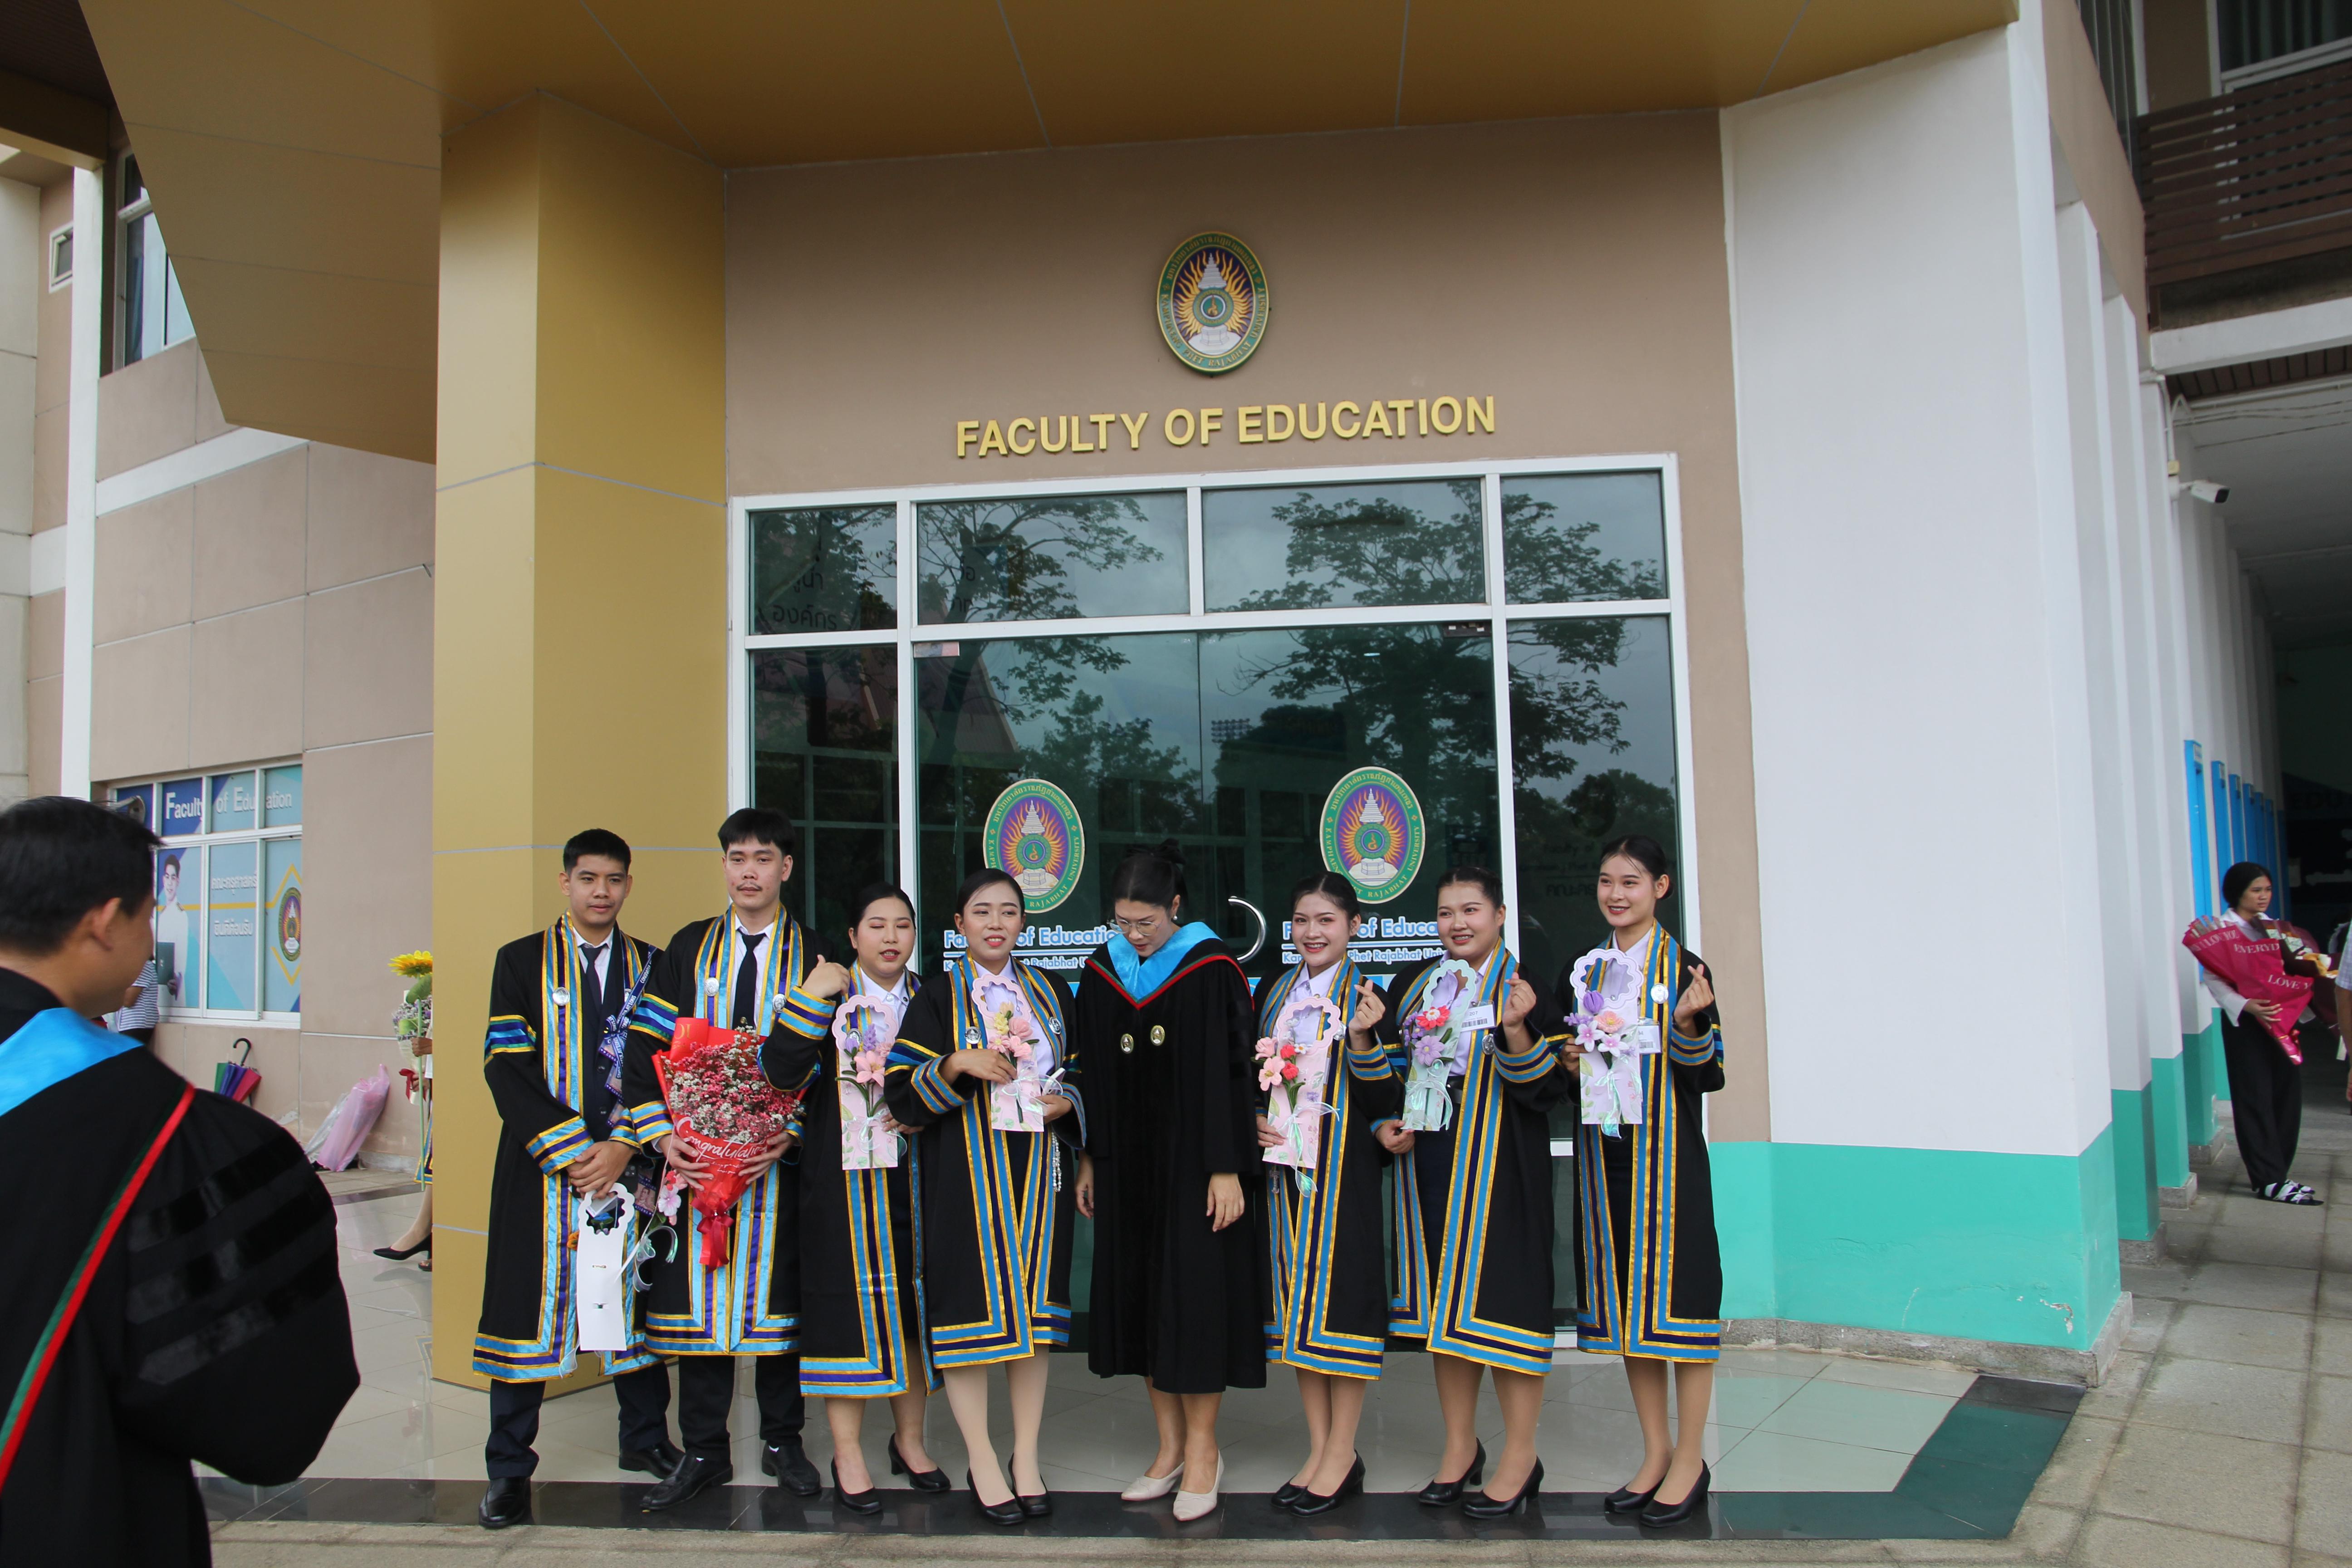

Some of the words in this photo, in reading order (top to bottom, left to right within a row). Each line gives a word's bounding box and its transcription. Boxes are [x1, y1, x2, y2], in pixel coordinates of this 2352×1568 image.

[1161, 294, 1183, 349] KAMPHAENG
[1183, 348, 1204, 365] PHET
[1208, 342, 1251, 368] RAJABHAT
[1250, 287, 1266, 339] UNIVERSITY
[957, 412, 1148, 457] FACULTY
[1164, 407, 1224, 446] OF
[1238, 395, 1495, 444] EDUCATION
[216, 791, 228, 813] of
[233, 786, 293, 813] Eduation
[988, 839, 997, 868] KAMPH
[1029, 885, 1069, 908] RAJABHAT
[1068, 836, 1079, 881] UNIVERSITY
[1367, 875, 1407, 898] RAJABHAT
[1407, 825, 1420, 872] UNIVERSITY
[1015, 927, 1034, 946] of
[1039, 925, 1118, 946] Educatio
[1357, 918, 1377, 938] of
[1381, 916, 1438, 937] Educa
[1348, 949, 1371, 963] Phet
[1374, 948, 1421, 965] Rajabhat
[2234, 942, 2279, 954] EVERYD
[1031, 956, 1078, 969] Rajabhat
[2268, 974, 2301, 989] LOVE
